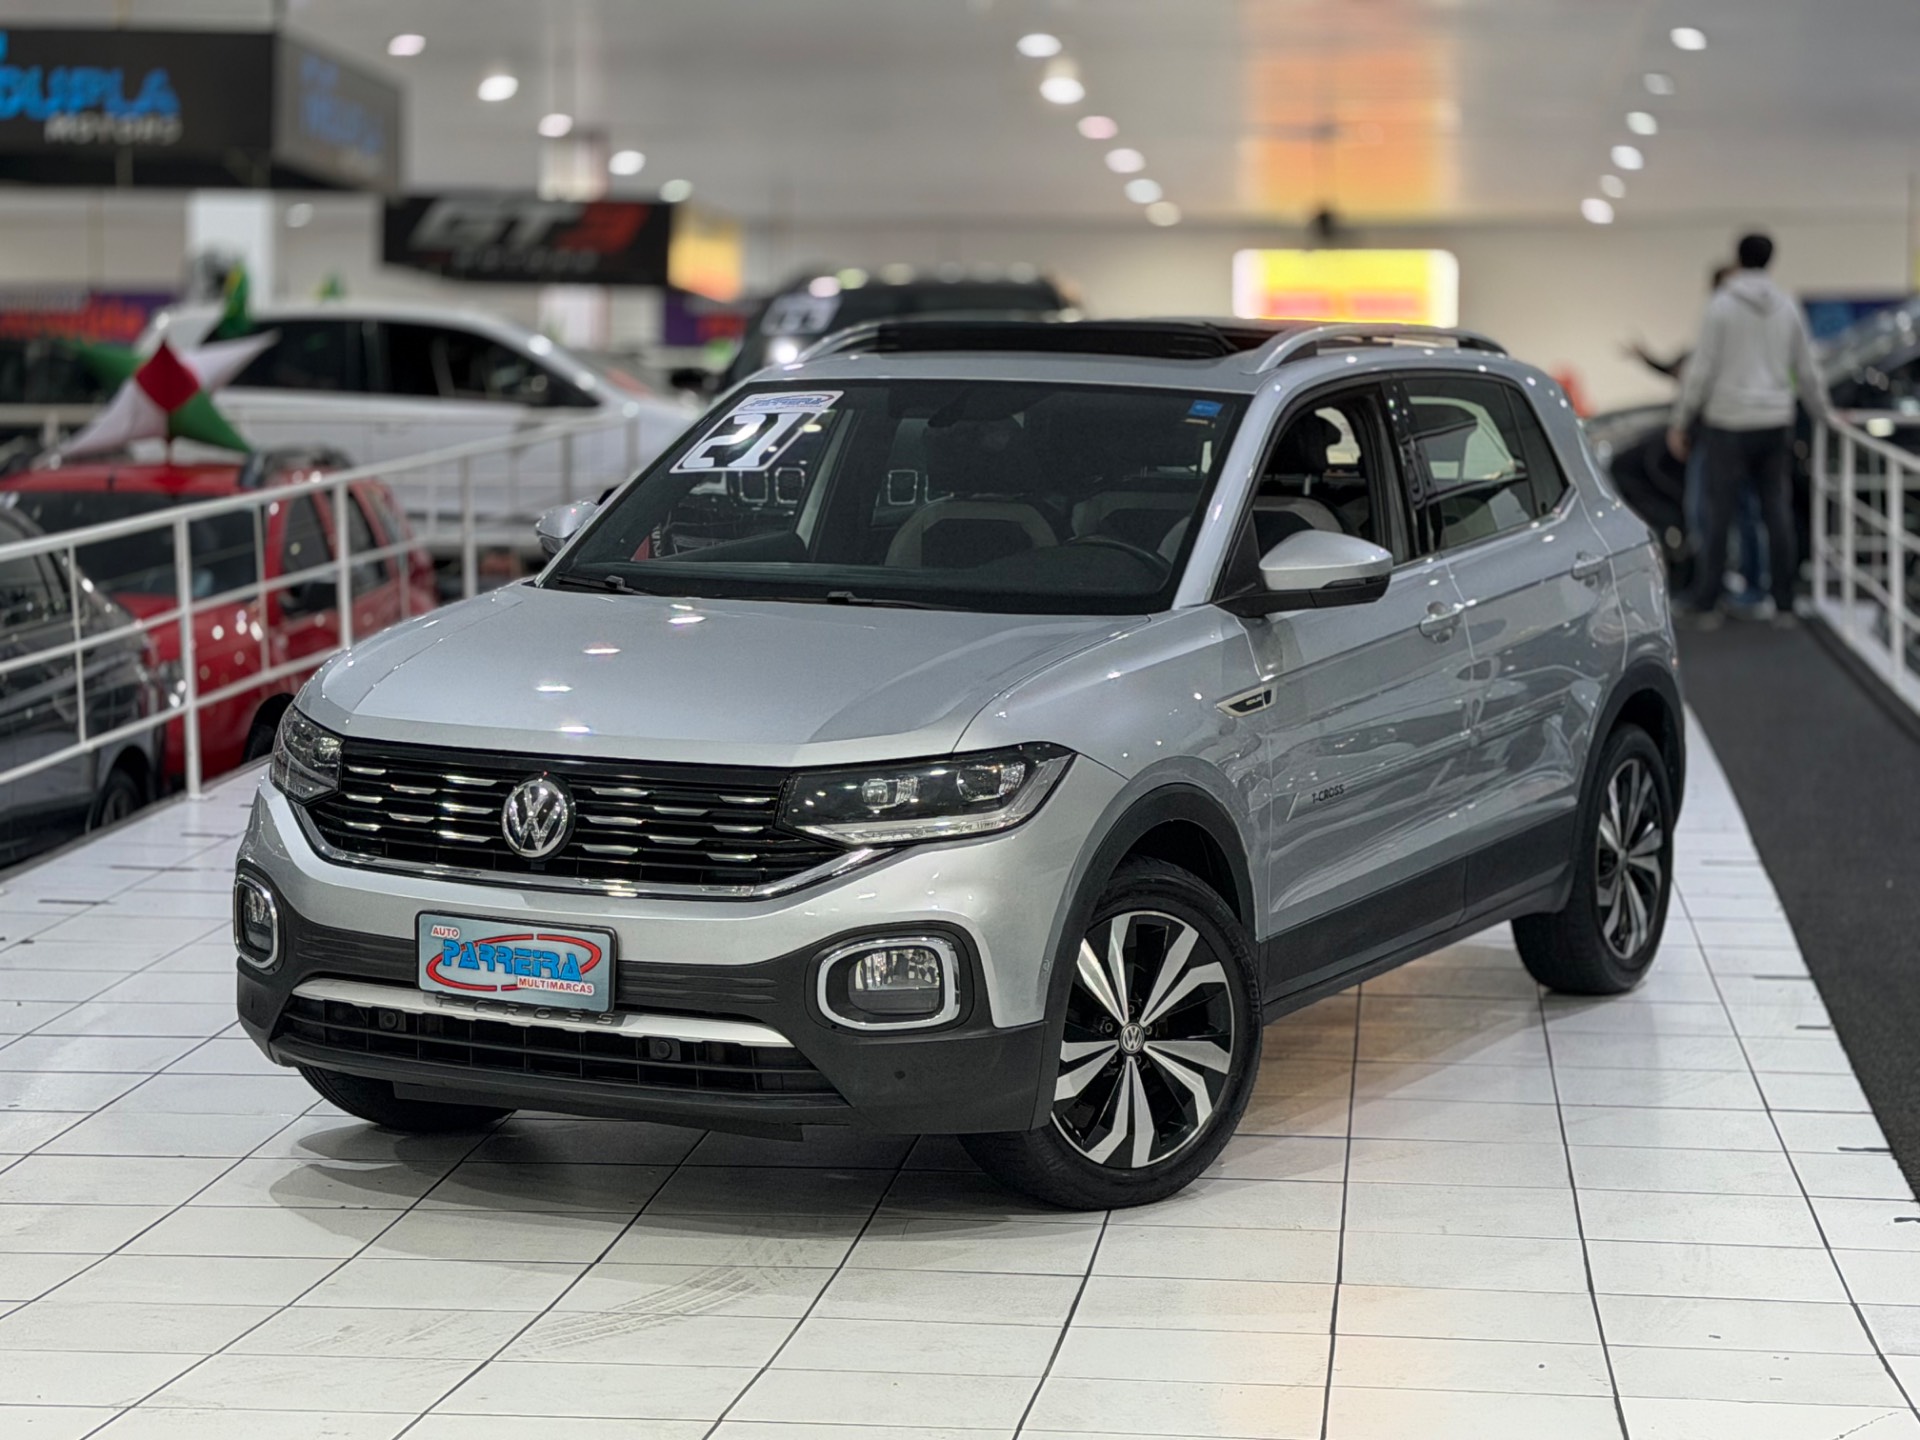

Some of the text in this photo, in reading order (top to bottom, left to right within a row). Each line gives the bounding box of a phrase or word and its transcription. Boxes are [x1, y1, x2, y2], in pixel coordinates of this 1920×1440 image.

[682, 413, 804, 469] 21
[1311, 783, 1345, 805] T-CROSS
[432, 926, 460, 938] AUTO
[442, 938, 583, 983] PARREIRA
[518, 977, 594, 995] MULTIMARCAS
